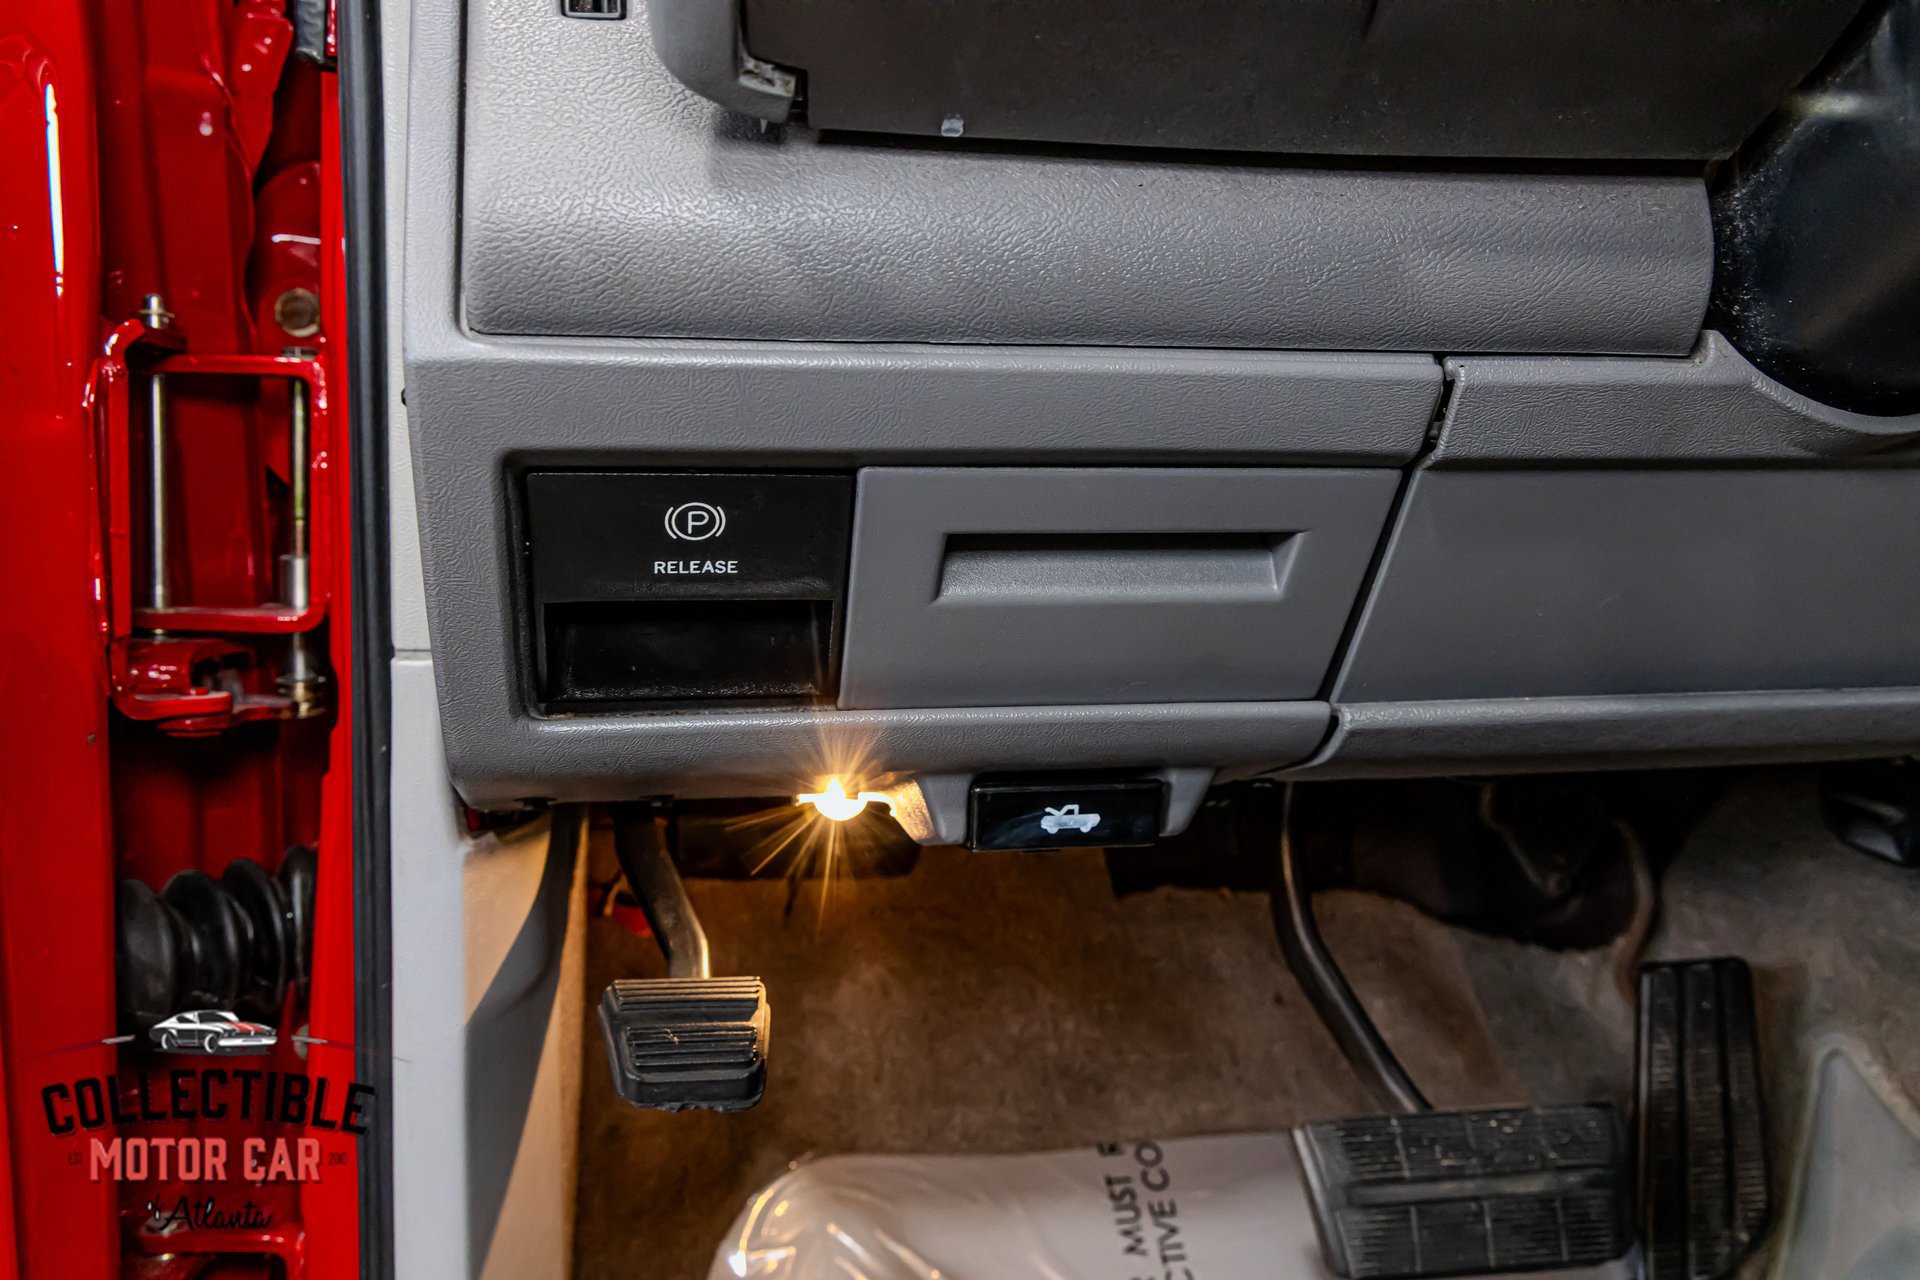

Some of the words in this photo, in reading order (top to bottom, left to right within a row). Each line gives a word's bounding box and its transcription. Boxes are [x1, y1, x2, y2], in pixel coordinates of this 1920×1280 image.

[653, 560, 739, 575] RELEASE
[1134, 1139, 1171, 1193] CO
[1105, 1174, 1148, 1257] MUST
